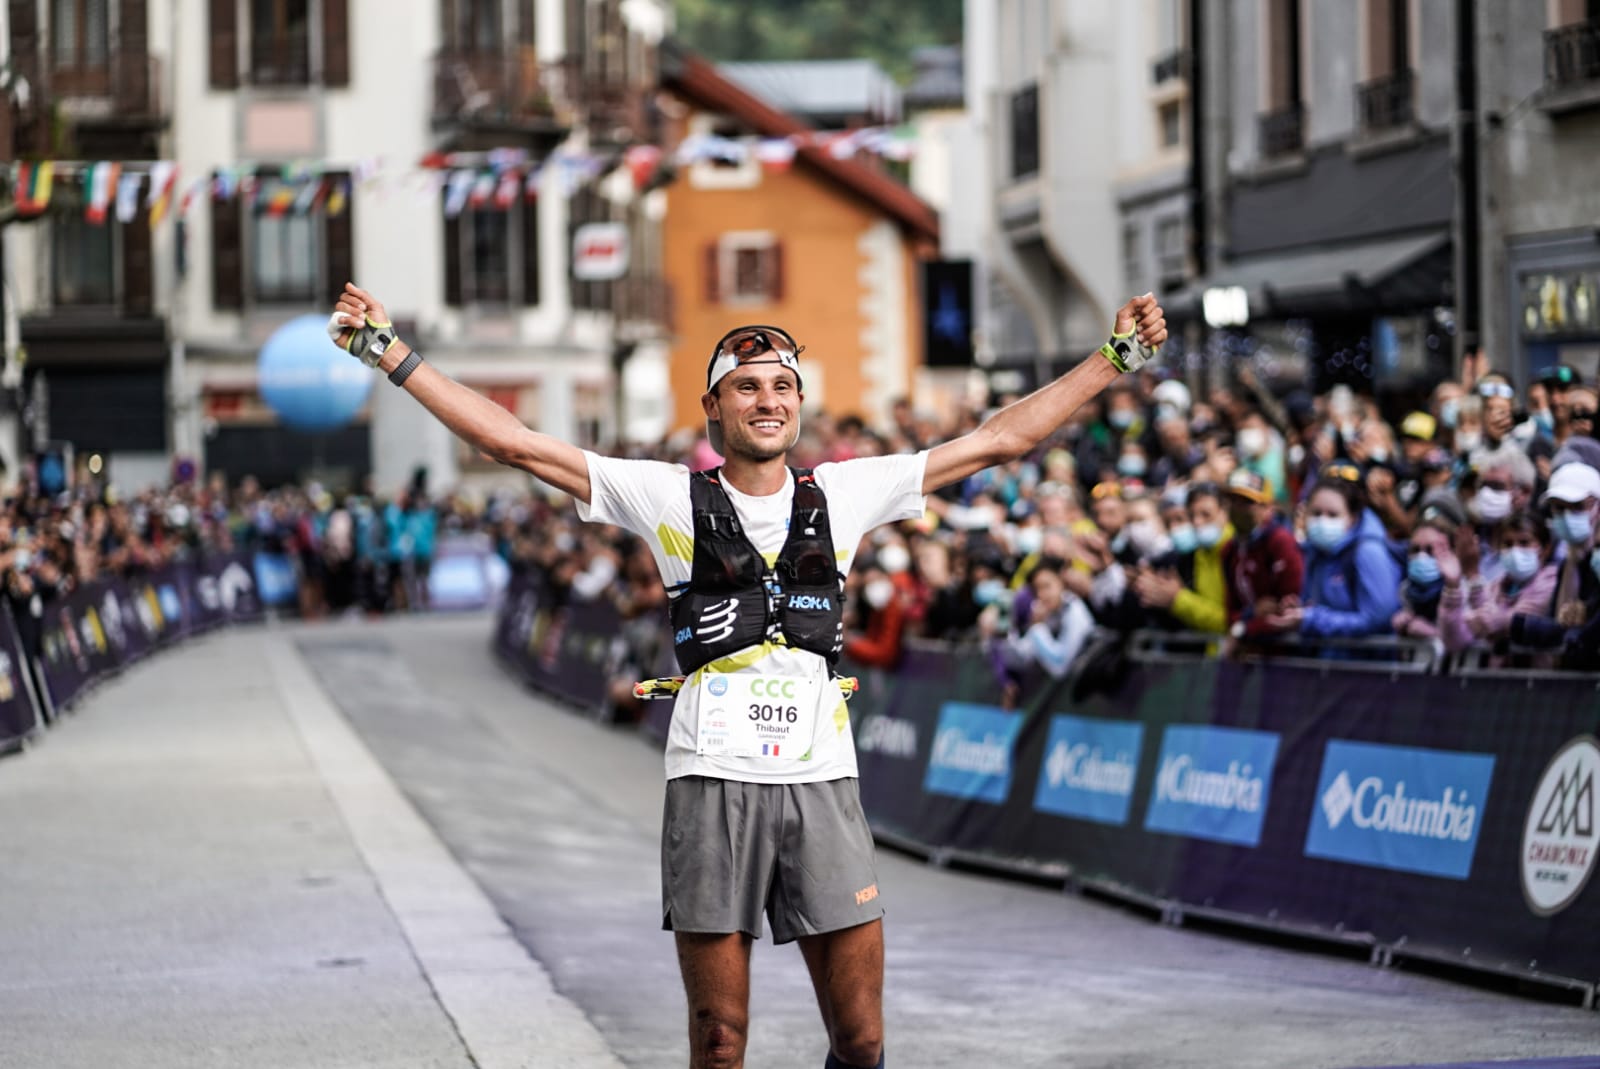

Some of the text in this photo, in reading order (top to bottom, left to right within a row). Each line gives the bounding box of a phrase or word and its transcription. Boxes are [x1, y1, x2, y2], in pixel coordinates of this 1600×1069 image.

[788, 595, 831, 611] HOKA
[750, 678, 796, 699] CCC
[748, 703, 798, 723] 3016
[755, 723, 790, 734] Thibaut
[1167, 753, 1263, 812] Cumbia
[1352, 776, 1477, 842] Columbia
